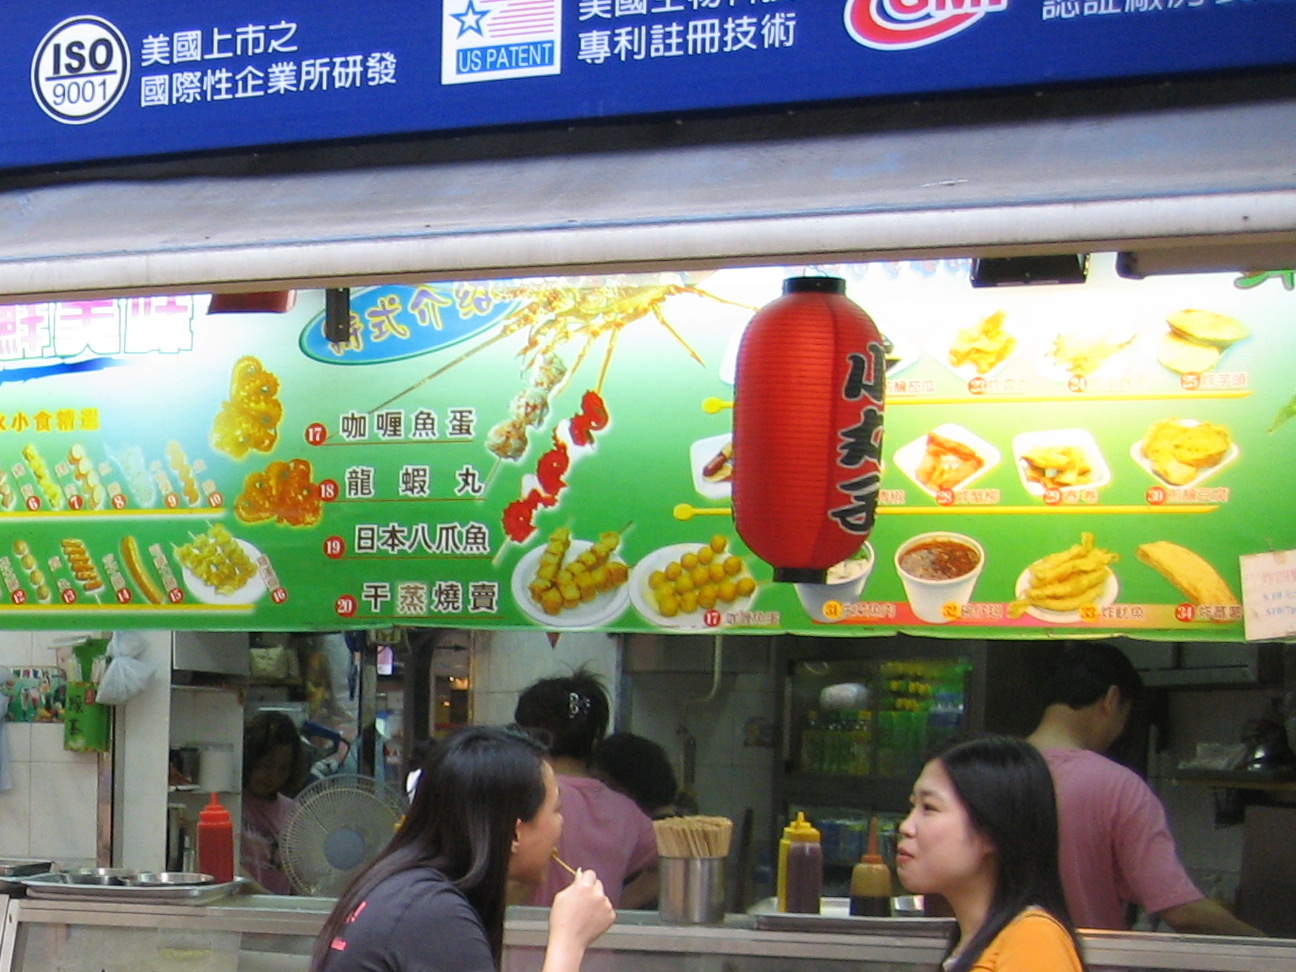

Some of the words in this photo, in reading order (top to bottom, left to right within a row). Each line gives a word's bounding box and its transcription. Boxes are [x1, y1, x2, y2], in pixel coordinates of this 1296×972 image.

[140, 21, 299, 67] 美國上市之
[577, 12, 798, 65] 專利註冊技術
[51, 39, 114, 75] ISO
[458, 51, 483, 73] US
[486, 43, 552, 70] PATENT
[51, 76, 111, 107] 9001
[139, 52, 399, 108] 國際性企業所研發
[1181, 374, 1198, 389] 25
[307, 426, 324, 442] 17
[340, 410, 475, 440] 咖喱魚蛋
[320, 481, 336, 498] 18
[346, 466, 484, 499] 龍蝦丸
[1147, 488, 1165, 503] 30
[325, 539, 342, 555] 19
[355, 525, 490, 554] 日本八爪魚
[336, 598, 354, 614] 20
[363, 583, 497, 614] 干蒸燒賣
